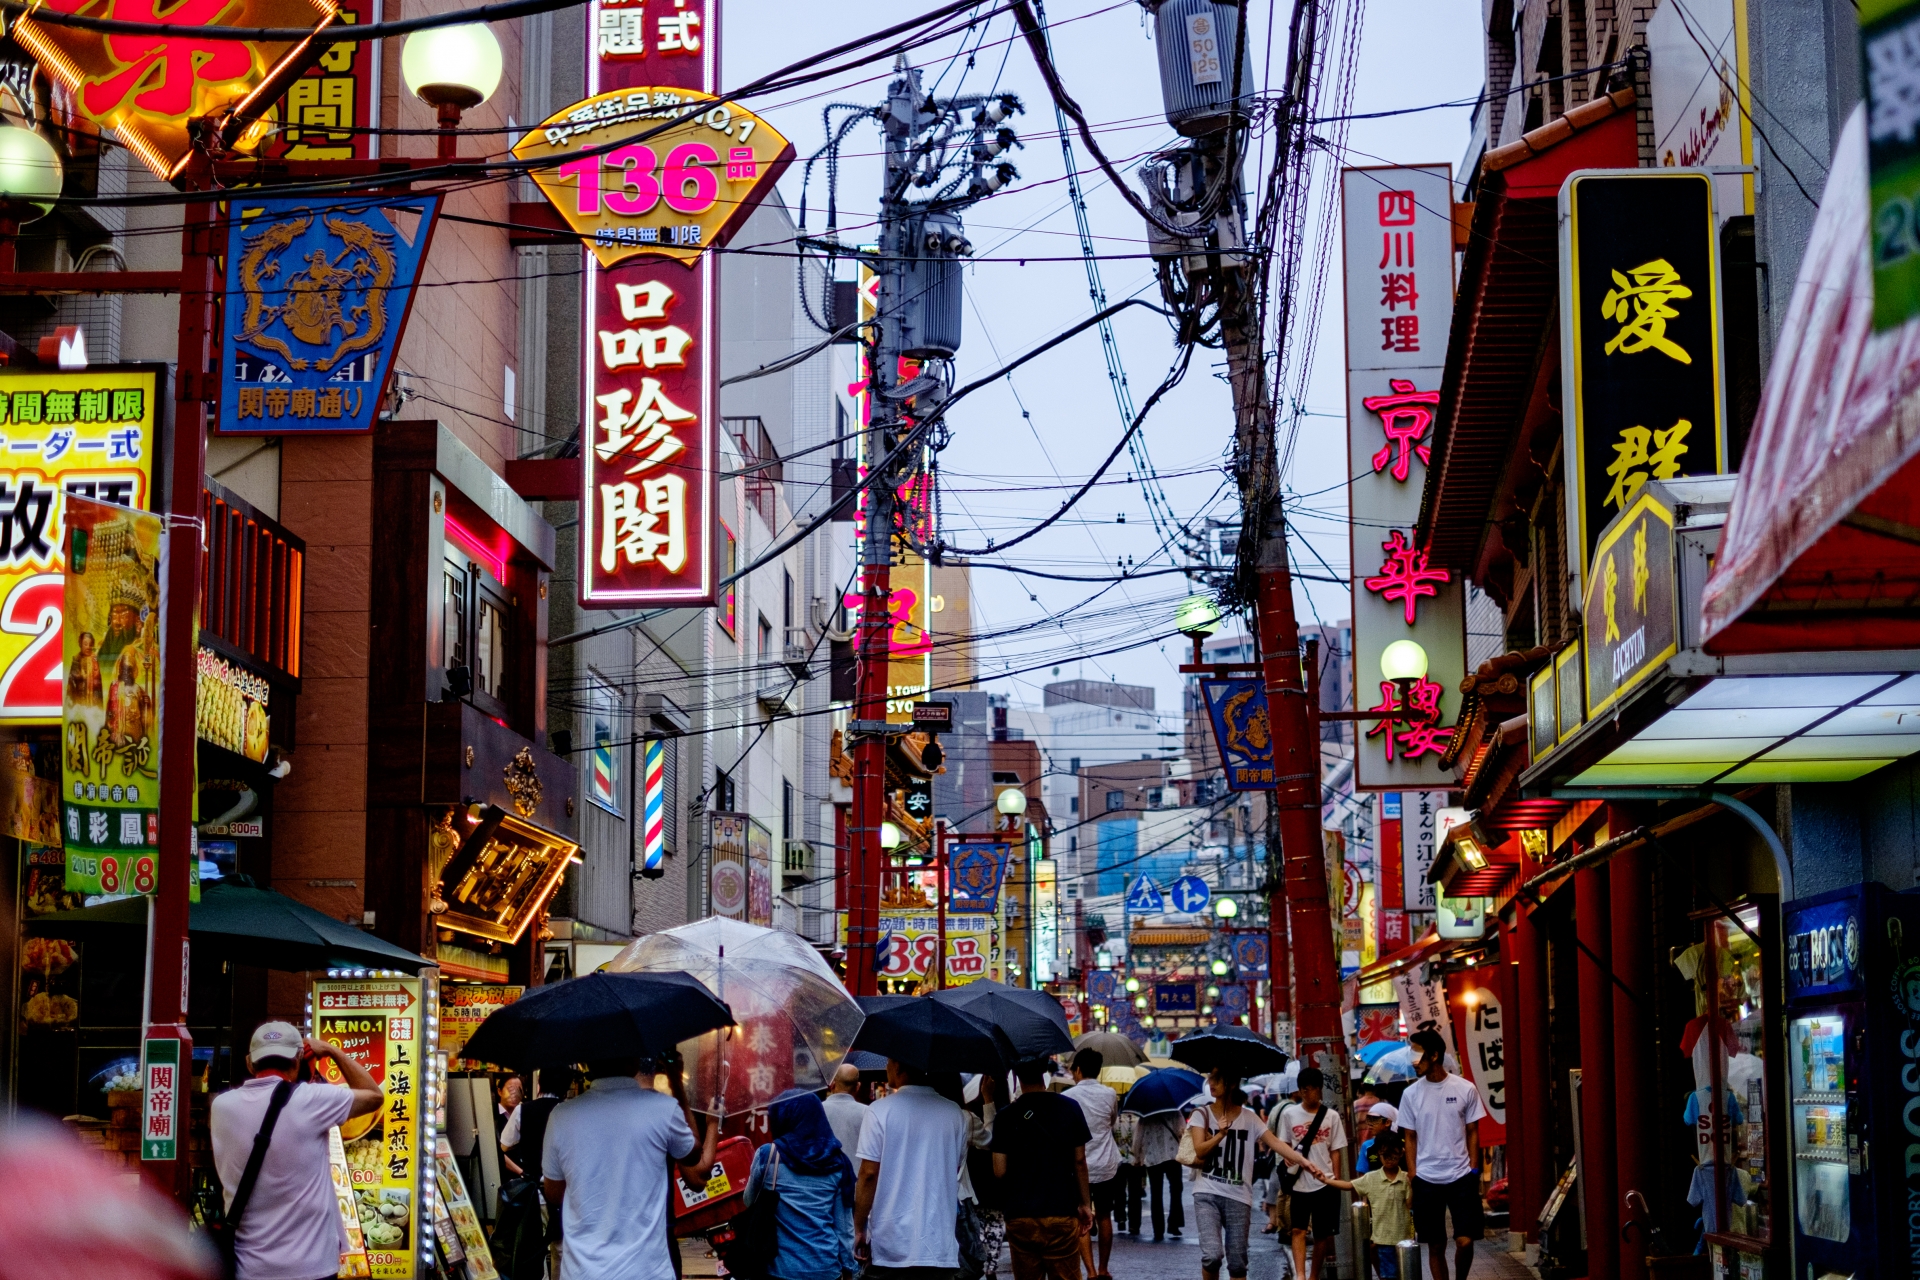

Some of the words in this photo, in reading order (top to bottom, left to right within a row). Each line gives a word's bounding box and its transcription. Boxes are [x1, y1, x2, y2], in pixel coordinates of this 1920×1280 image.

[1192, 38, 1213, 54] 50
[1192, 58, 1218, 75] 125
[595, 225, 702, 248] 時間無制限
[1378, 190, 1420, 353] 四川料理
[0, 389, 143, 422] 間無制限
[238, 386, 363, 420] 関帝廟通り
[595, 279, 697, 574] 品珍閣
[230, 822, 259, 835] 300円
[71, 855, 97, 877] 2015
[100, 856, 155, 894] 8/8
[322, 993, 409, 1008] お土産送料無料
[455, 987, 523, 1007] 飲み放題
[322, 1020, 383, 1034] 人気NO.1
[1471, 1001, 1506, 1110] たばこ
[148, 1066, 173, 1137] 関帝廟
[388, 1043, 412, 1180] 上海生煎包
